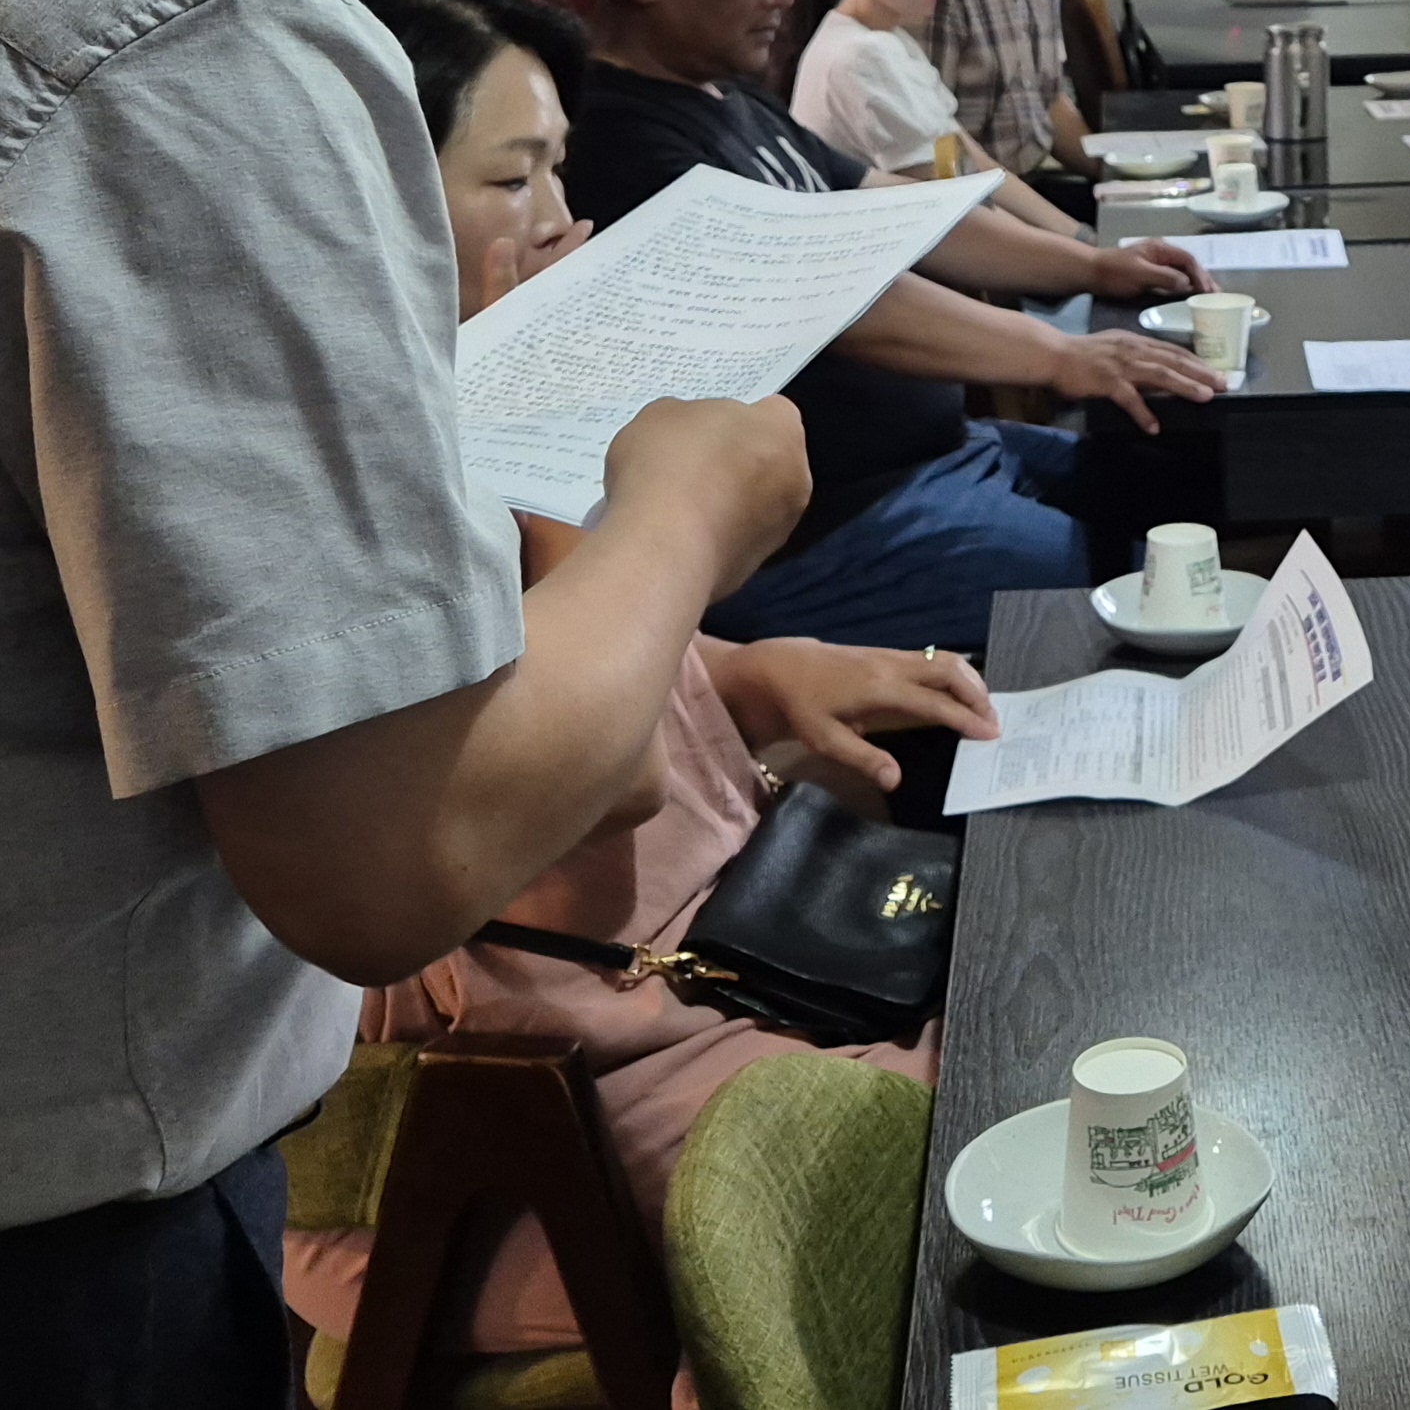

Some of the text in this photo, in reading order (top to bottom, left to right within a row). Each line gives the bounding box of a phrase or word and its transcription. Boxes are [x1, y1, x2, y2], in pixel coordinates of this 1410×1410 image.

[1115, 1363, 1229, 1390] WET TISSUE
[1184, 1372, 1269, 1393] GOLD
